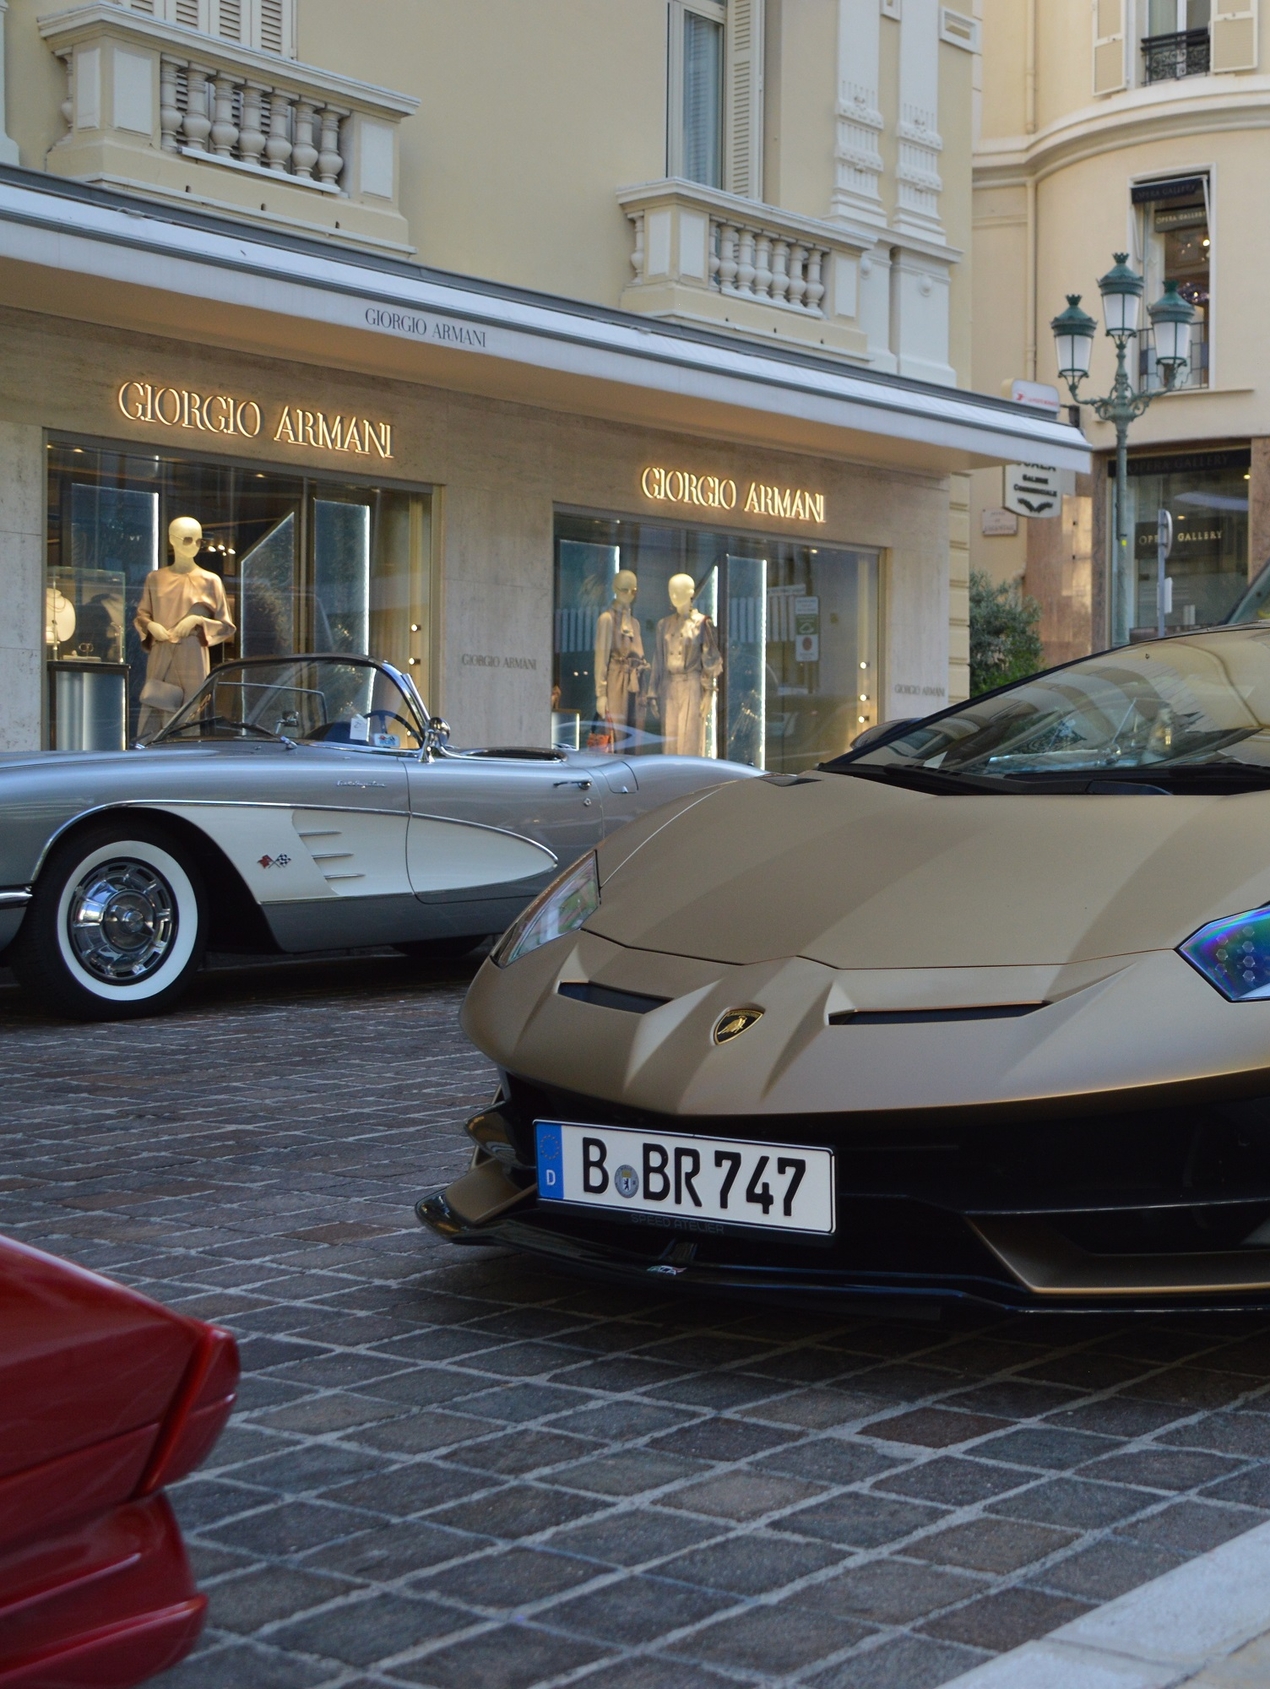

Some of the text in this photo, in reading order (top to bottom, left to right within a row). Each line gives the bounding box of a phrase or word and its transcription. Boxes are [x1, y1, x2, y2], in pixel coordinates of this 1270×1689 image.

[1156, 215, 1178, 225] OPERA
[365, 308, 486, 347] GIORGIO ARMANI
[118, 381, 394, 459] GIORGIO ARMANI
[1174, 454, 1229, 468] GALLERY
[641, 466, 827, 523] GIORGIO ARMANI
[1177, 531, 1223, 542] GALLERY
[461, 653, 537, 670] GIORGIO ARMANI
[894, 684, 945, 697] GIORGIO ARMANI
[546, 1170, 556, 1186] D
[582, 1137, 609, 1194] B
[642, 1142, 703, 1207] BR
[714, 1150, 806, 1217] 747
[630, 1213, 725, 1234] SPEED ATELIER
